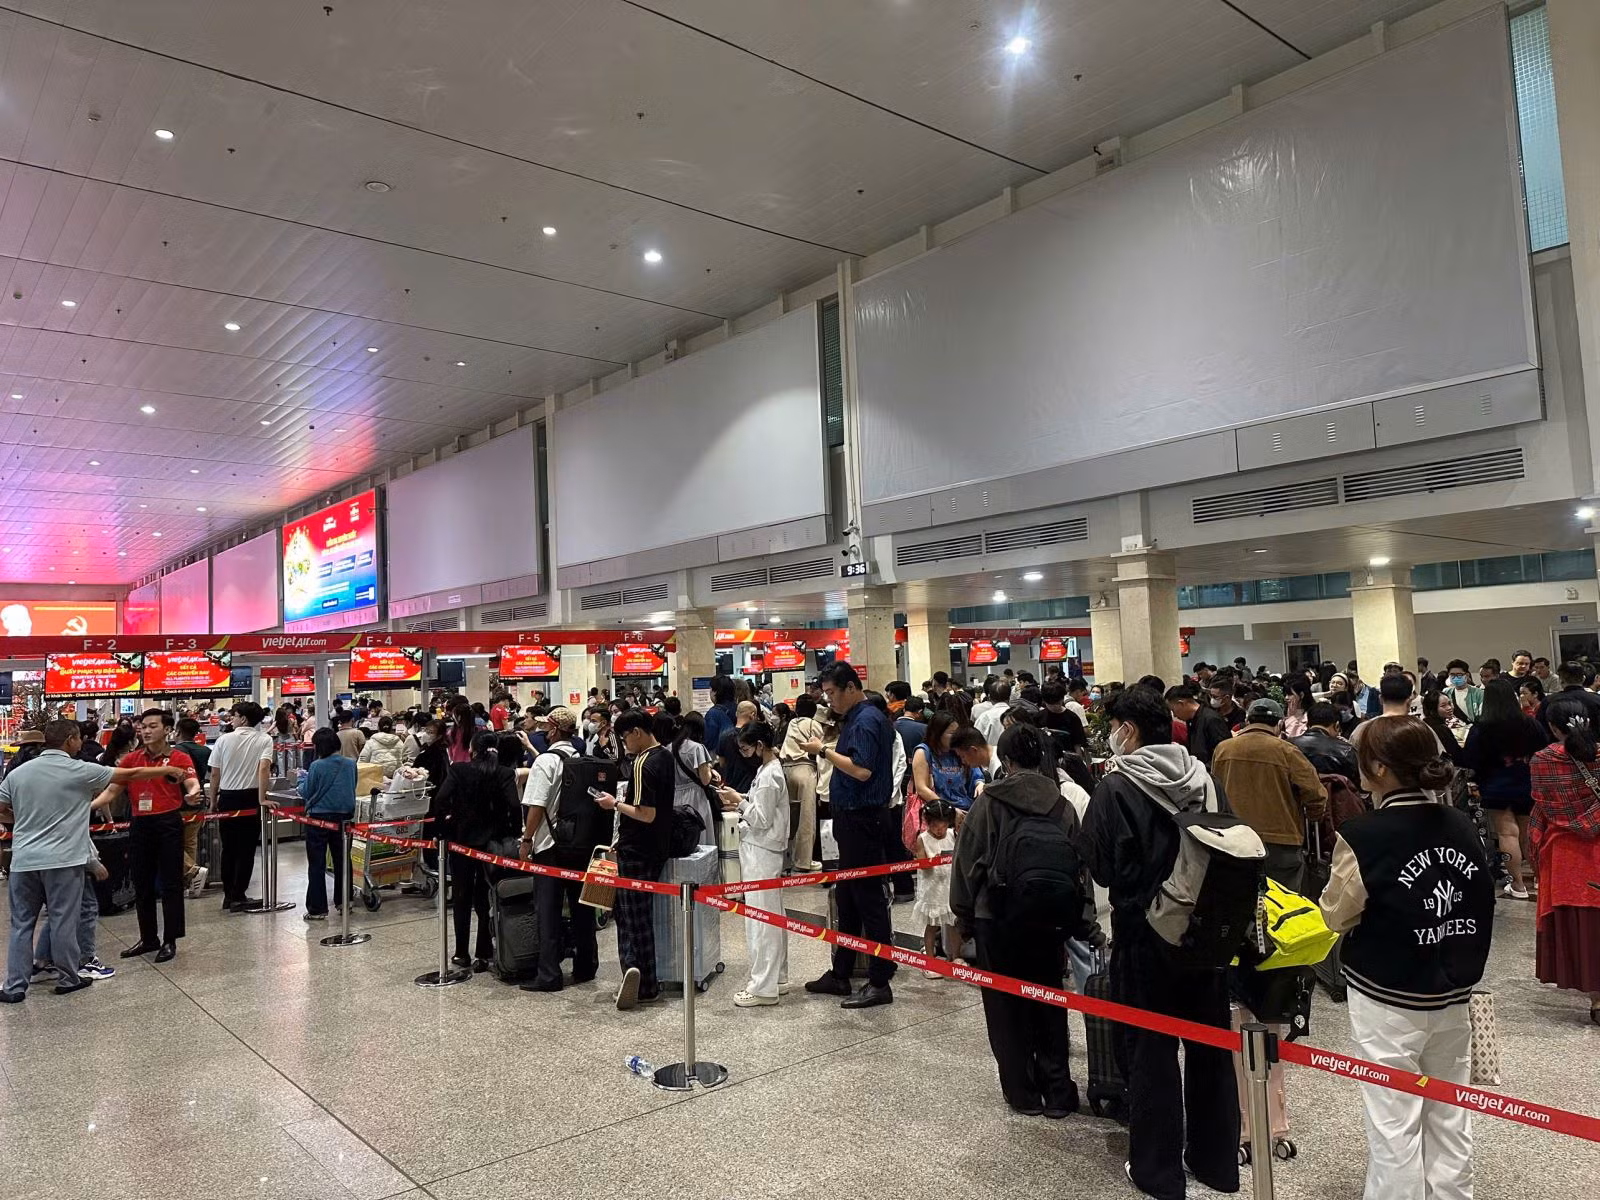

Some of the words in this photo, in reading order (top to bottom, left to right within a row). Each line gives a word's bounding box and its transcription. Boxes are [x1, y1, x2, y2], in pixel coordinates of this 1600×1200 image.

[847, 563, 866, 575] 9:36
[1397, 849, 1431, 889] NEW
[1434, 847, 1479, 880] YORK
[1423, 898, 1435, 909] 19
